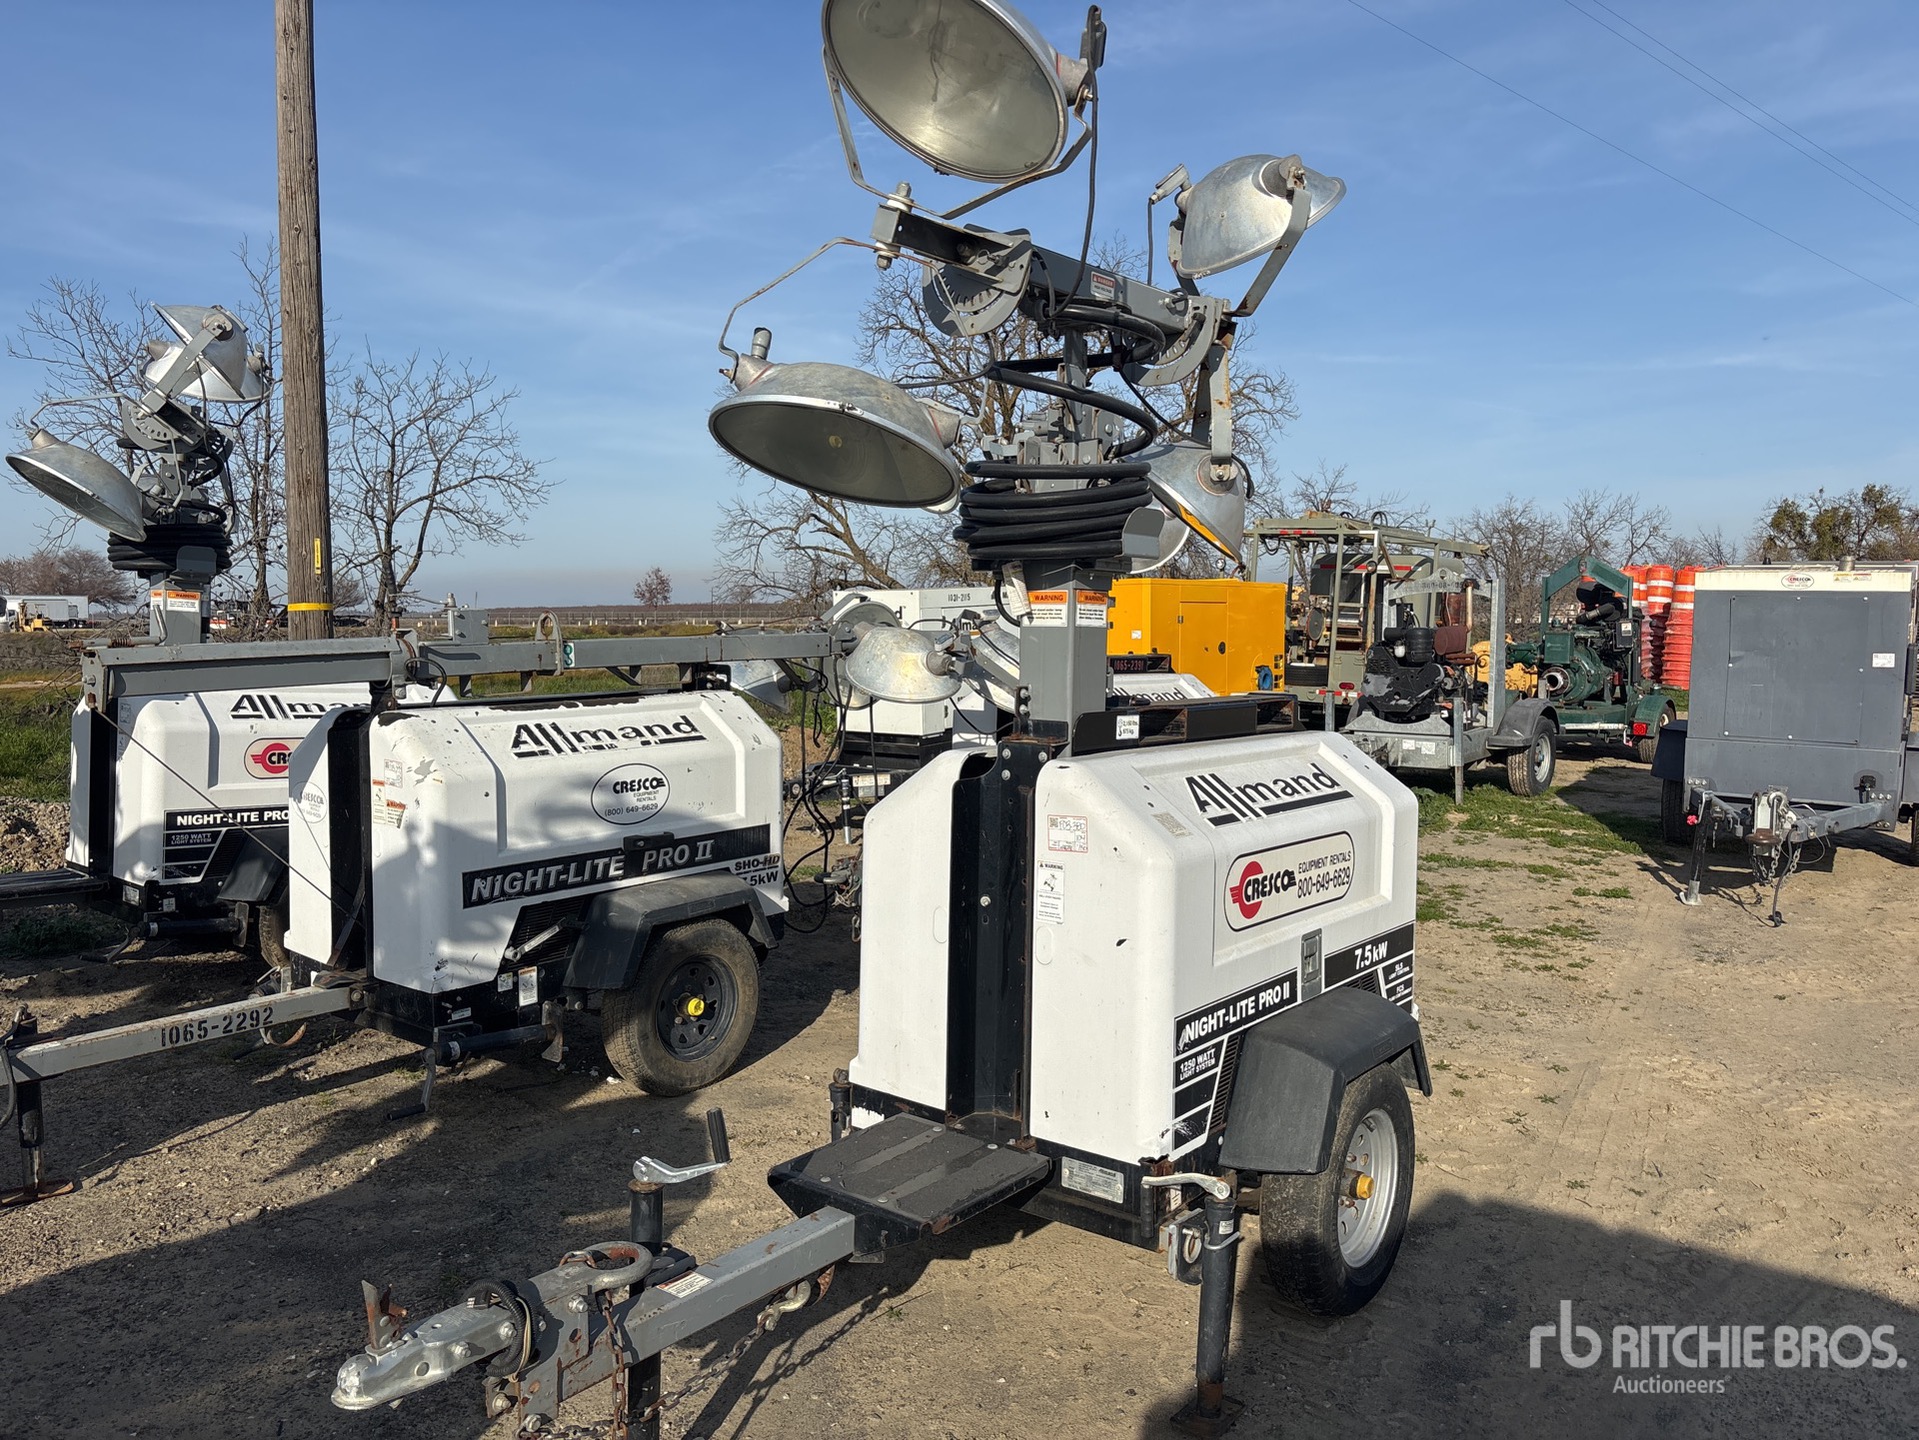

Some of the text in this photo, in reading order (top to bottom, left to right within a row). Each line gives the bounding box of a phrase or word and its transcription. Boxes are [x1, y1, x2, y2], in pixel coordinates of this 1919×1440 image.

[1084, 594, 1105, 602] WARNING
[511, 715, 700, 753] Allmand
[613, 776, 666, 794] CRESCO
[633, 789, 660, 798] EQUIPMENT
[1185, 762, 1341, 819] Allmand
[177, 811, 260, 826] NIGHT-LITE
[604, 802, 659, 817] (800) 649-6629
[190, 832, 212, 840] WATT
[471, 839, 716, 901] NIGHT-LITE PRO II
[734, 854, 780, 871] SHO-HD
[1298, 850, 1352, 874] EQUIPMENT RENTALS
[1243, 869, 1297, 902] CRESCO
[1297, 866, 1350, 899] 800-649-6629
[1184, 980, 1290, 1042] NIGHT-LITE PRO II
[161, 1006, 274, 1047] 1065-2292
[1180, 1048, 1216, 1073] 1250 WATT
[1180, 1058, 1216, 1081] LIGHT SYSTEM
